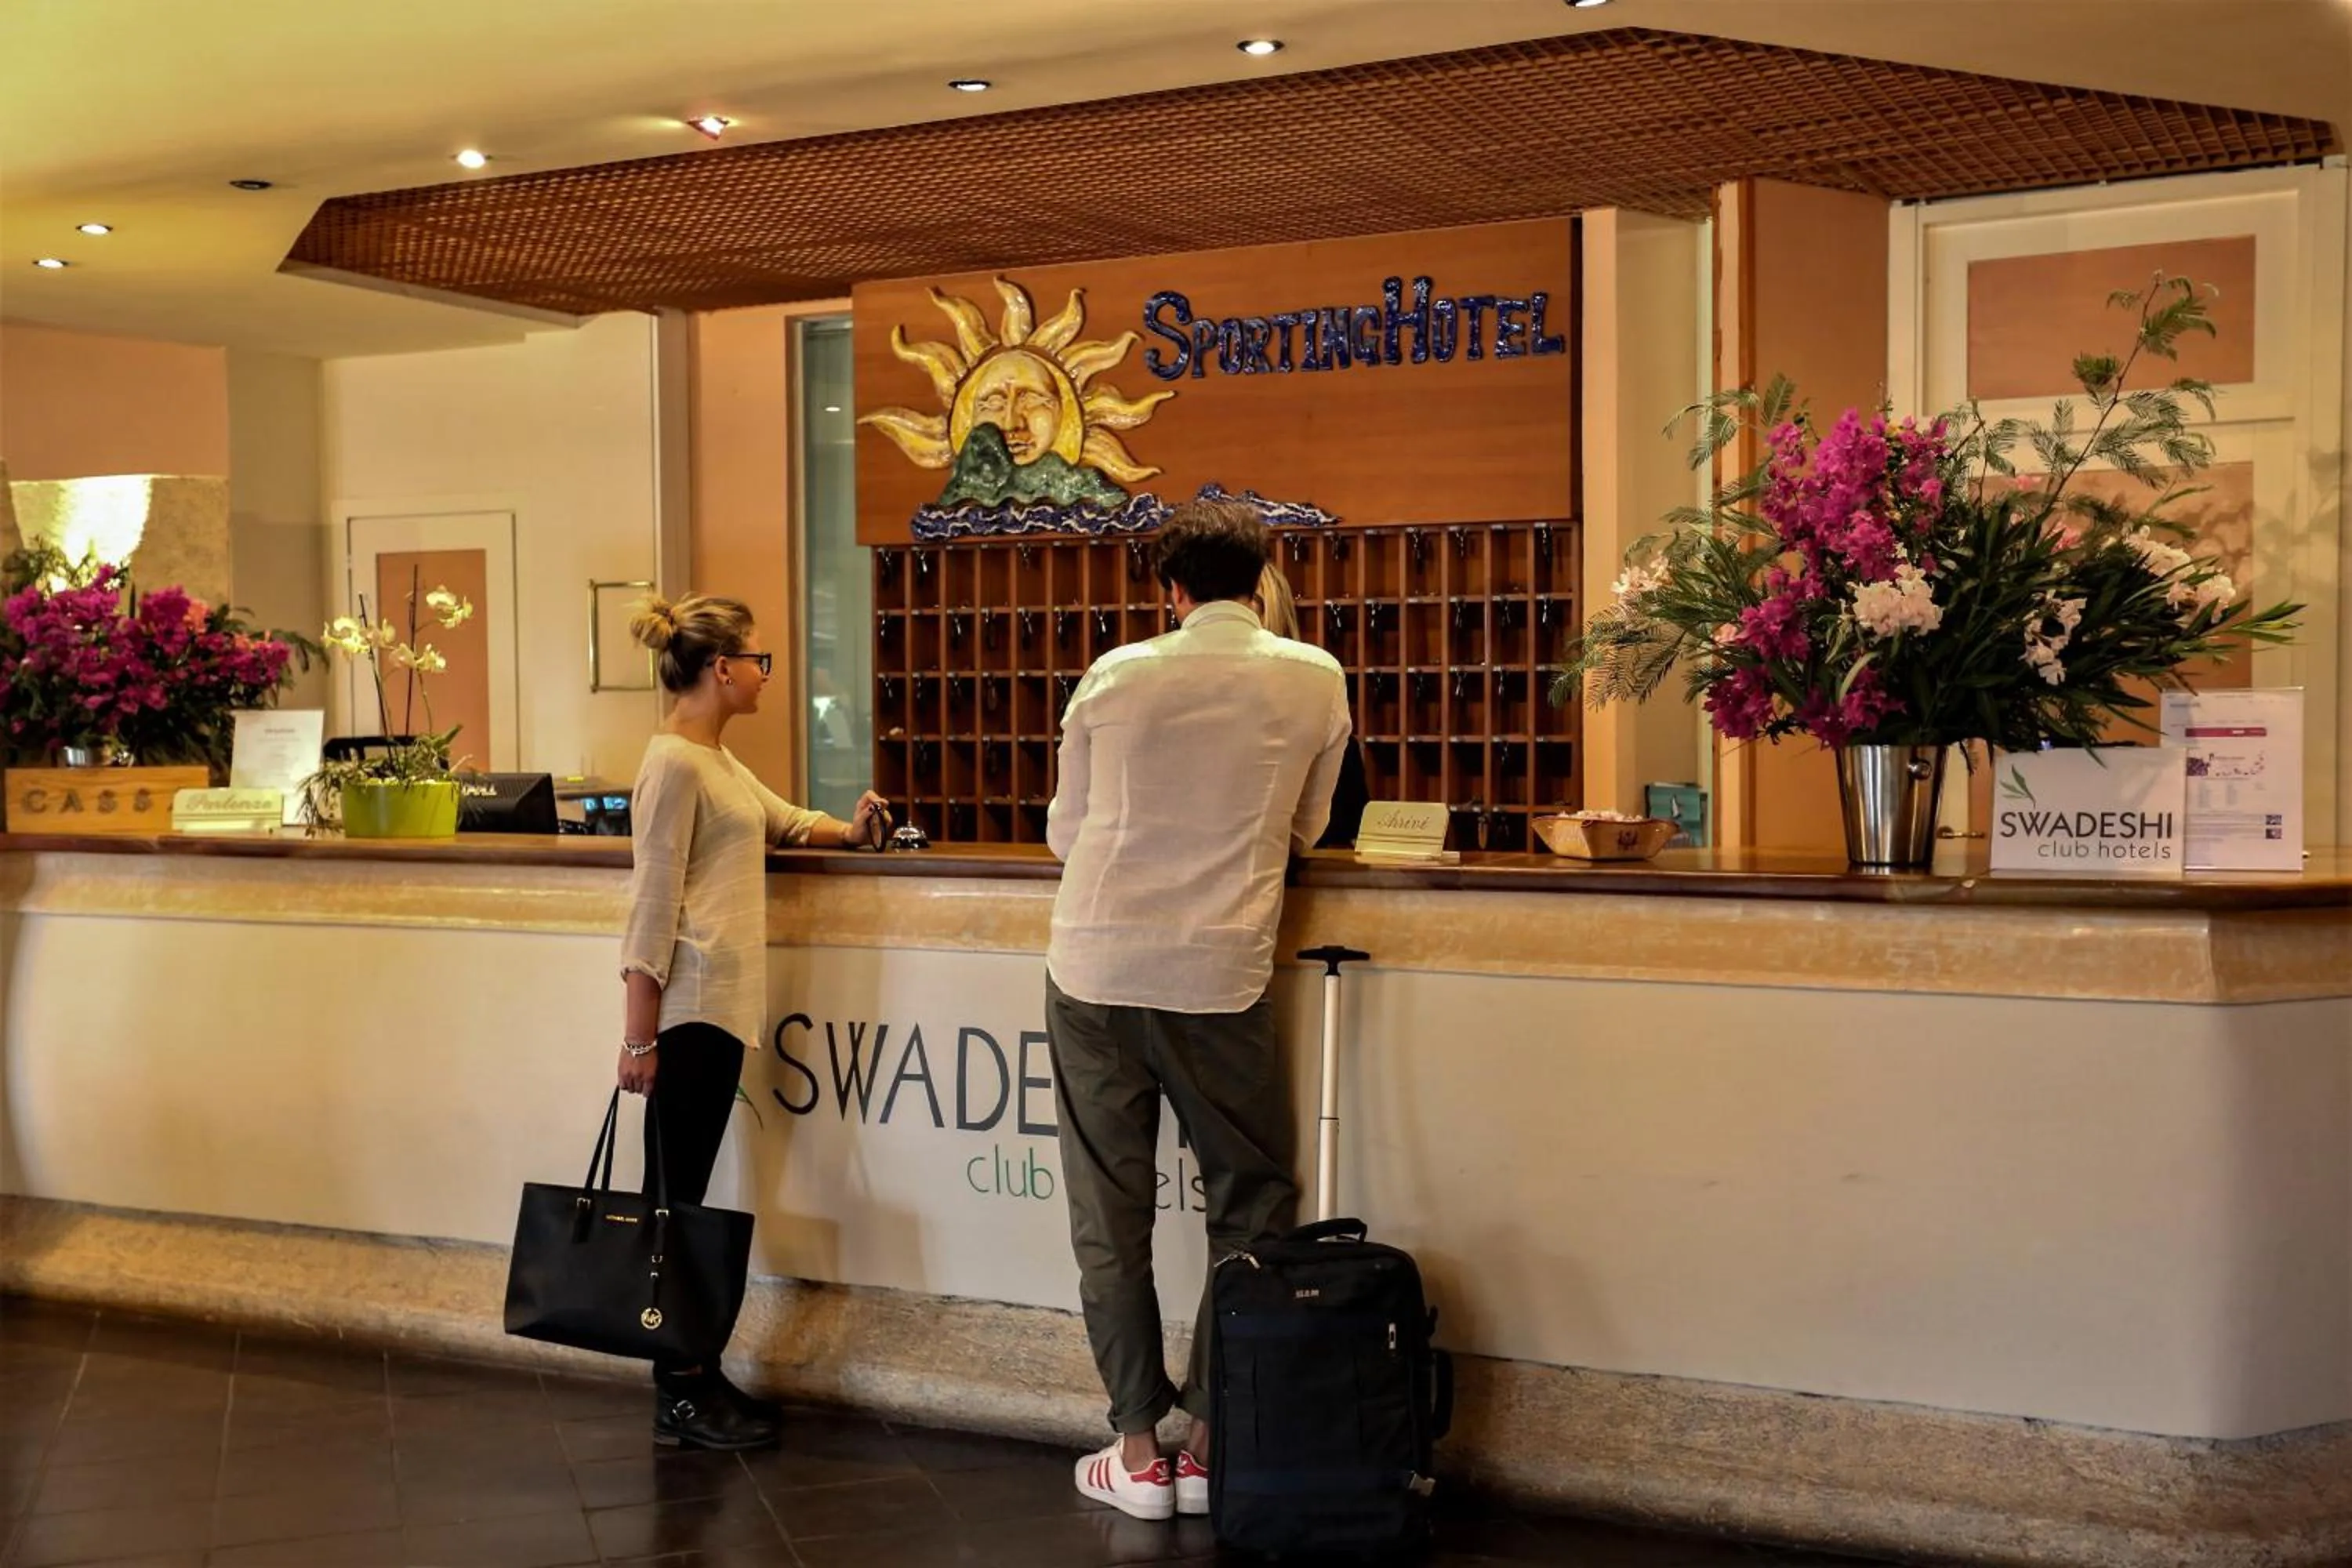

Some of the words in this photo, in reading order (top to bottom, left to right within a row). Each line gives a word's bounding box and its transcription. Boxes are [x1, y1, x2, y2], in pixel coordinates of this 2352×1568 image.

[20, 789, 172, 814] CASS
[2000, 811, 2172, 838] SWADESHI
[2038, 840, 2089, 858] club
[2099, 840, 2171, 859] hotels
[772, 1012, 1188, 1149] SWADE
[967, 1145, 1054, 1200] club
